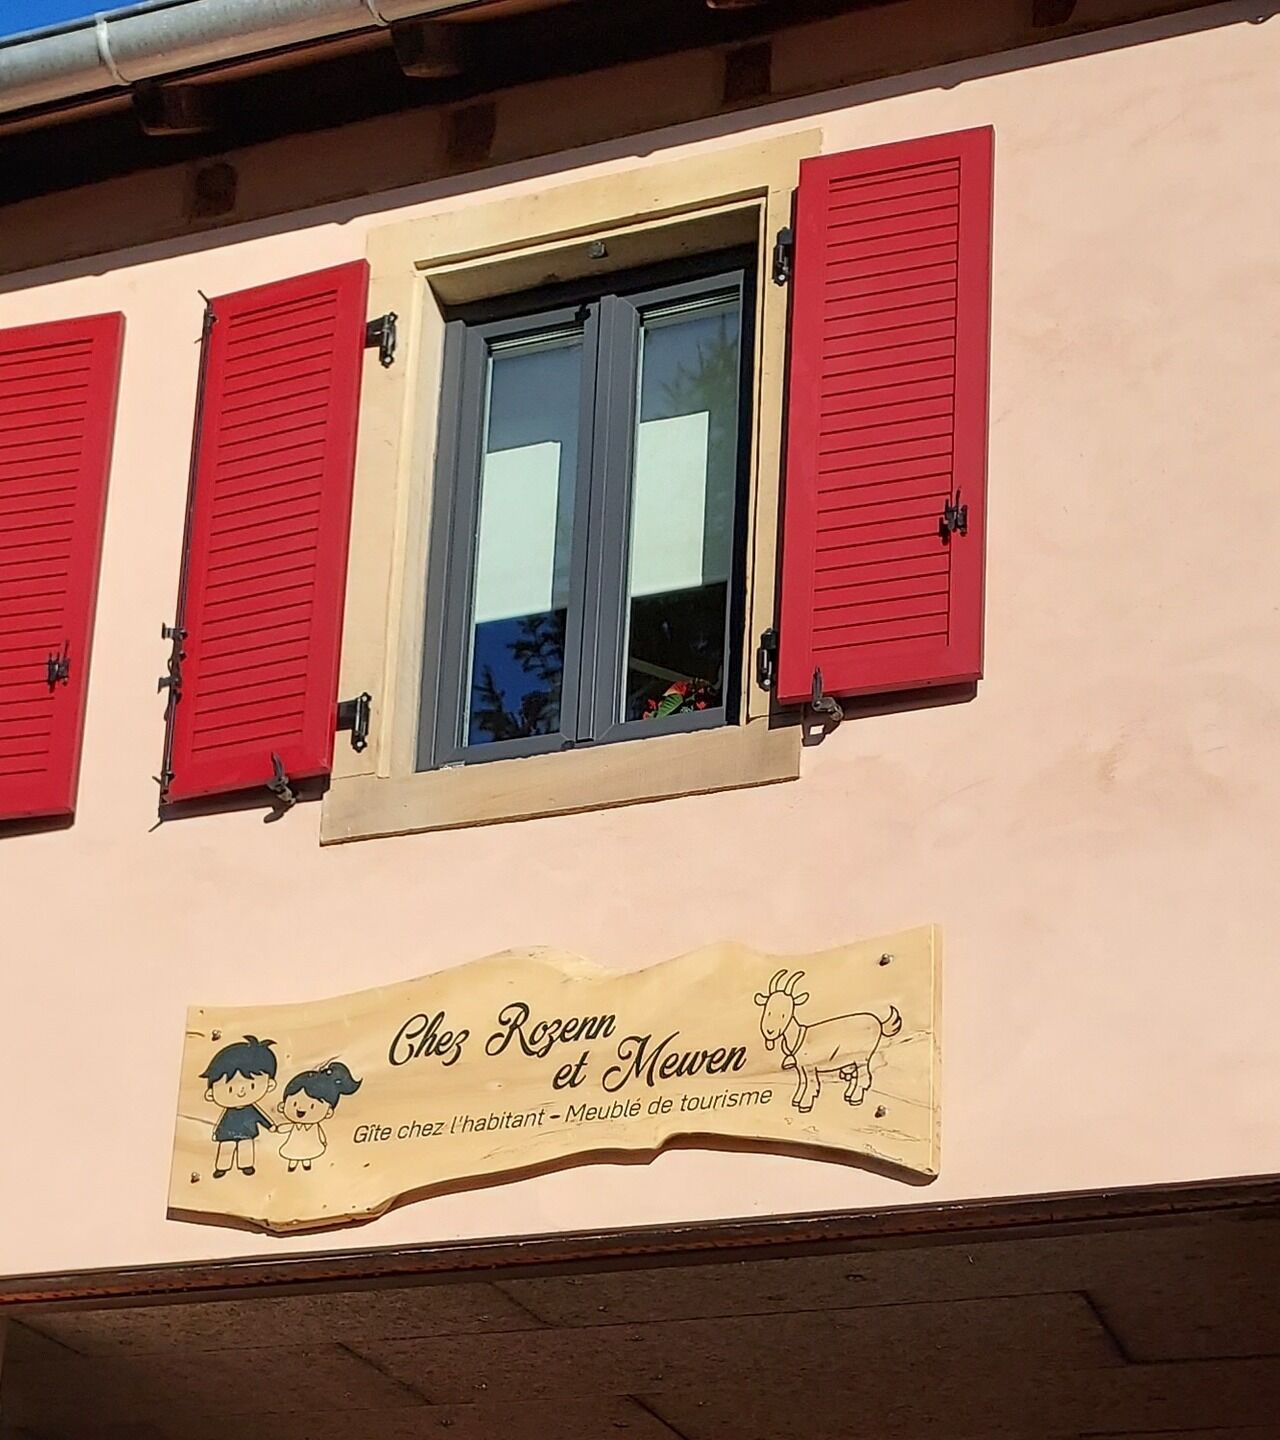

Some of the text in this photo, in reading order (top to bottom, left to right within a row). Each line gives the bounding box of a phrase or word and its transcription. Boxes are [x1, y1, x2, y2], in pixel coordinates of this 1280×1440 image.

[389, 1002, 616, 1066] Chez Rozenn
[552, 1031, 747, 1093] et Mewen
[353, 1123, 392, 1143] Gîte
[397, 1120, 444, 1139] chez
[449, 1108, 545, 1134] l'habitant
[565, 1098, 641, 1123] Meublé
[647, 1096, 673, 1115] de
[680, 1089, 773, 1113] tourisme
